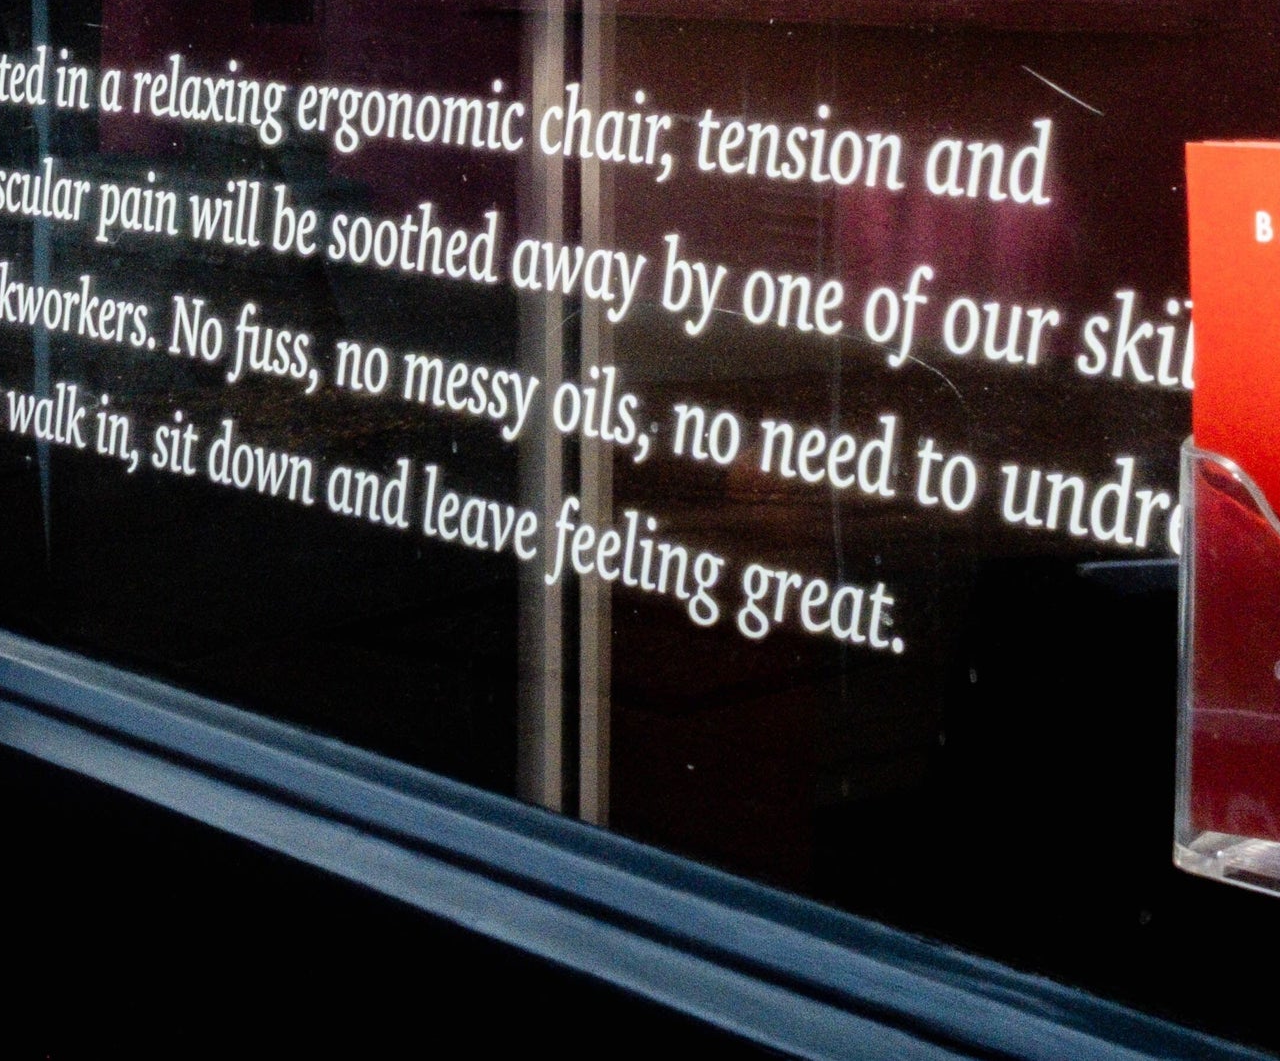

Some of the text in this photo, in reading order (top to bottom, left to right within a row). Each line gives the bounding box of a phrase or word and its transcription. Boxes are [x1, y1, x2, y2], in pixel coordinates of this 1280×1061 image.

[56, 48, 90, 110] in
[99, 69, 123, 113] a
[133, 53, 288, 146] relaxing
[297, 79, 526, 154] ergonomic
[538, 83, 673, 183] chair,
[697, 104, 905, 192] tension
[923, 118, 1052, 207] and
[95, 170, 179, 243] pain
[188, 179, 262, 248] will
[272, 183, 318, 256] be
[327, 201, 499, 283] soothed
[511, 238, 648, 324] away
[661, 233, 728, 337] by
[742, 270, 845, 336] one
[863, 264, 935, 368] of
[942, 296, 1061, 366] our
[168, 295, 223, 362] No
[226, 302, 319, 395] fuss,
[336, 341, 389, 395] no
[403, 353, 541, 441] messy
[550, 364, 650, 463] oils,
[673, 403, 741, 465] no
[760, 414, 897, 498] need
[916, 438, 978, 512] to
[6, 382, 87, 449] walk
[96, 393, 139, 473] in,
[151, 410, 199, 476] sit
[208, 418, 314, 505] down
[327, 458, 410, 529] and
[423, 464, 538, 561] leave
[543, 495, 725, 626] feeling
[737, 563, 904, 654] great.
